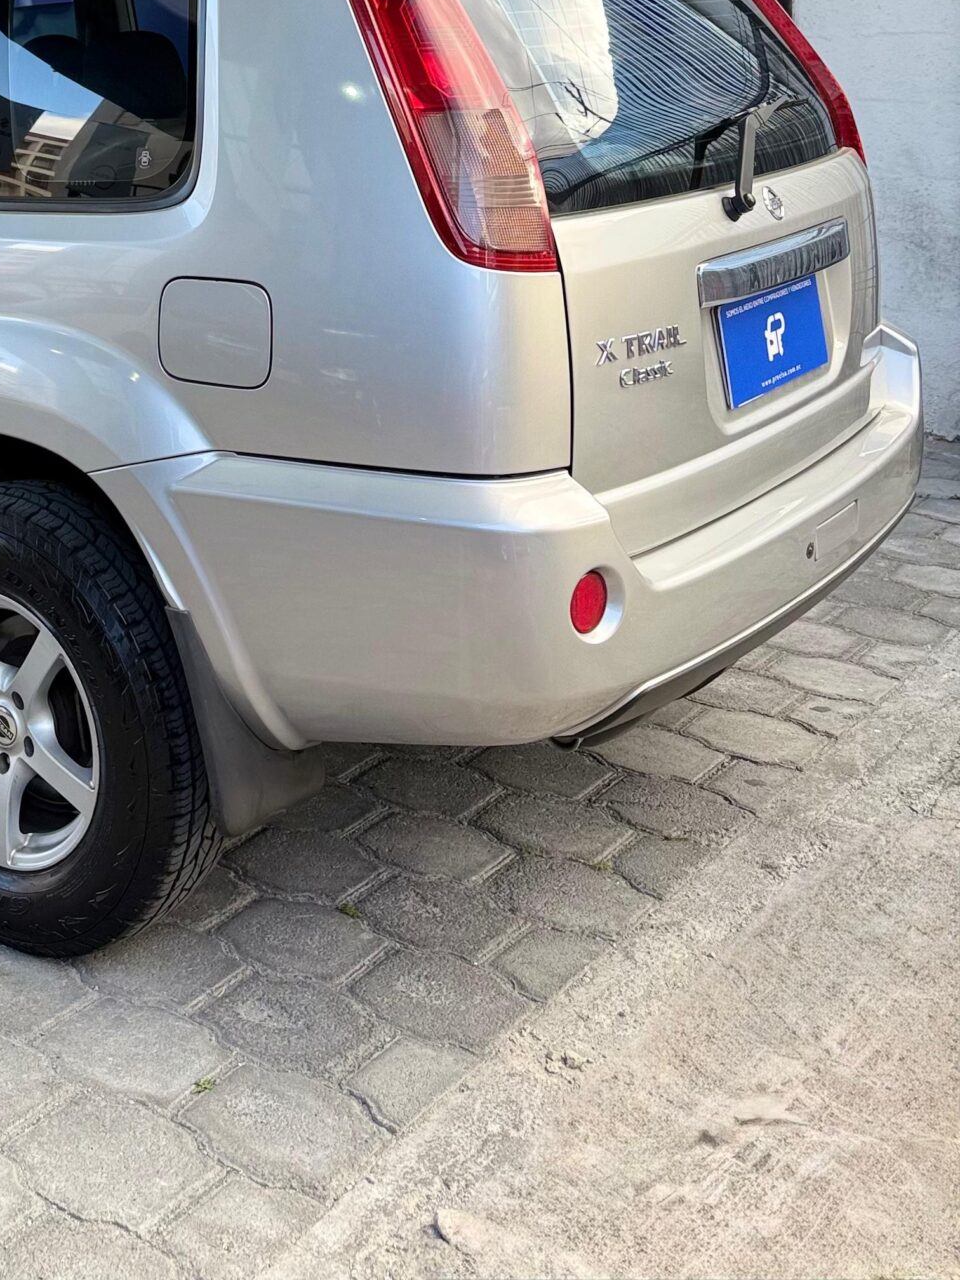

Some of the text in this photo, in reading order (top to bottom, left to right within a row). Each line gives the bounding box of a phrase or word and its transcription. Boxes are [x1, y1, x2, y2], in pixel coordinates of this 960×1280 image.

[595, 324, 687, 366] X TRAIL
[620, 360, 674, 388] Classic
